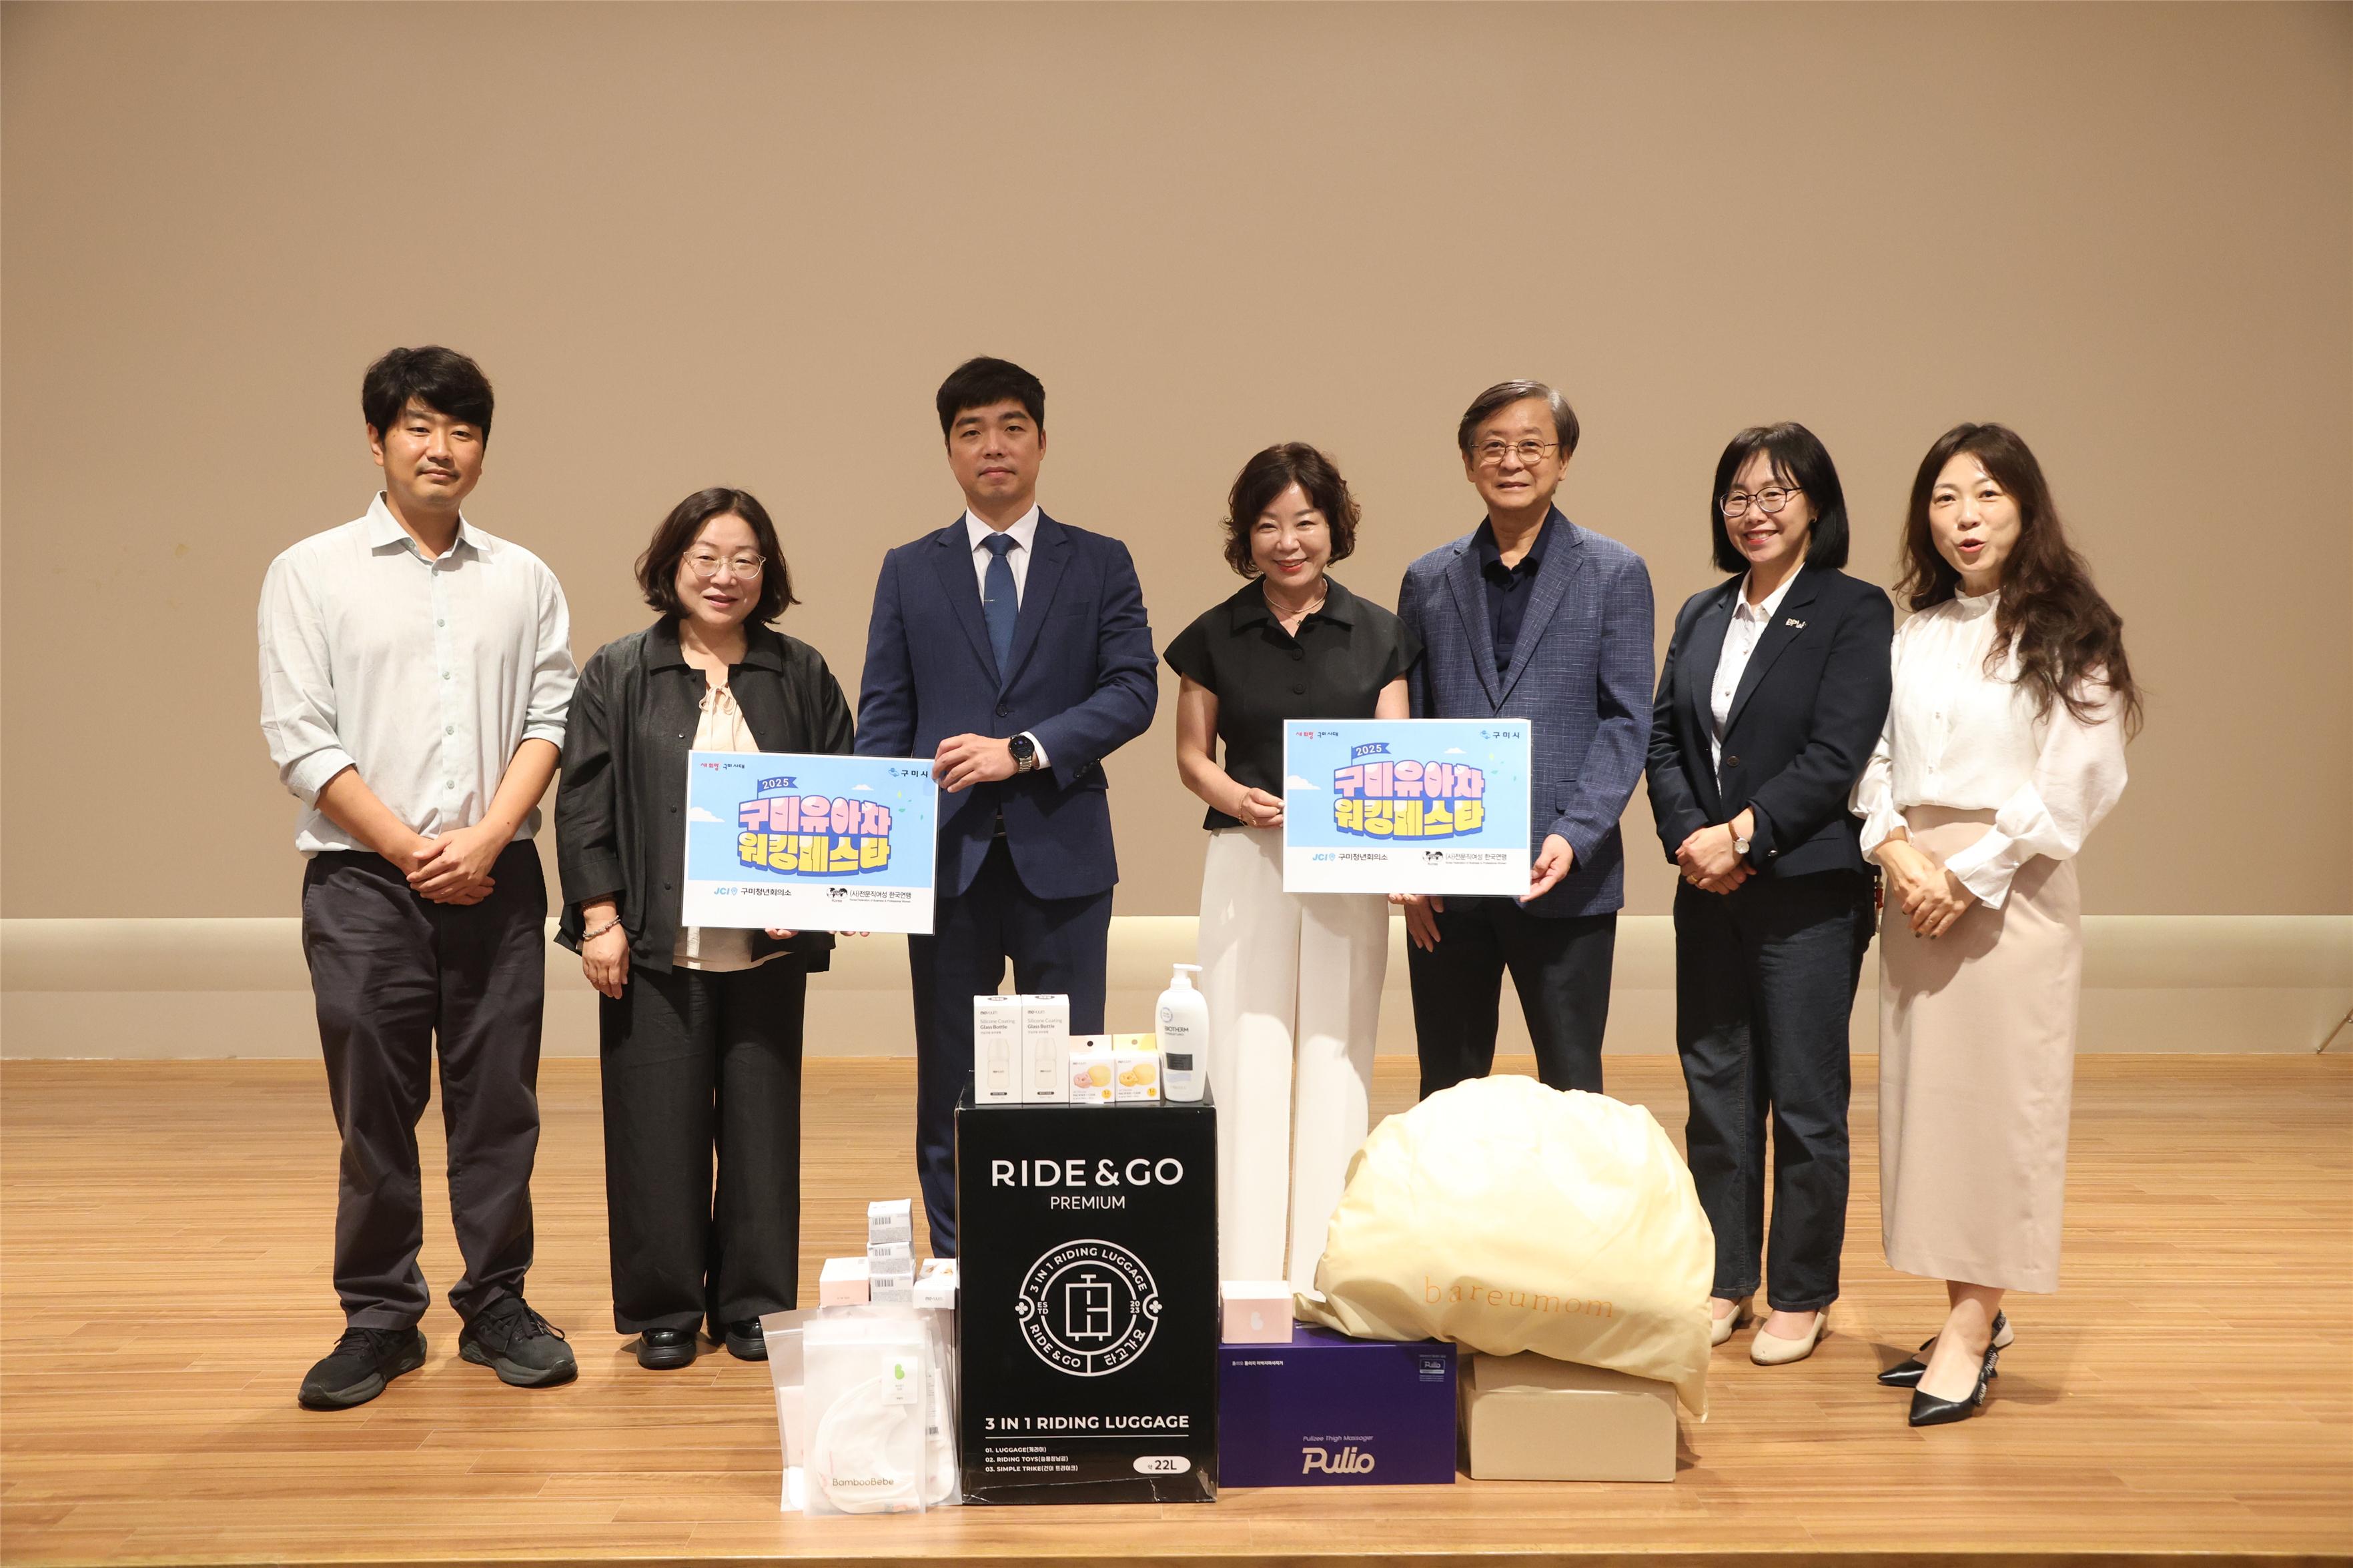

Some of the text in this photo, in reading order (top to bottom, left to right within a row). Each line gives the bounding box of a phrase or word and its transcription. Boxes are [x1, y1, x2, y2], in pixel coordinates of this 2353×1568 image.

[1356, 744, 1382, 756] 2025
[901, 770, 928, 778] 구미시
[1334, 760, 1485, 798] 구미유아차
[762, 778, 789, 790] 2025
[739, 795, 892, 836] 구미유아차
[1334, 798, 1485, 839] 워킹페스타
[737, 832, 891, 876] 워킹페스타
[1312, 853, 1328, 861] JCI
[1338, 853, 1388, 861] 구미청년회의소
[714, 887, 730, 895] JCI
[741, 888, 792, 896] 구미청년회의소
[991, 1159, 1086, 1187] RIDE
[1050, 1196, 1125, 1210] PREMIUM
[1029, 1285, 1039, 1293] 3
[1035, 1269, 1048, 1283] IN
[1053, 1247, 1097, 1265] RIDING
[1101, 1249, 1147, 1292] LUGGAGE
[1424, 1275, 1613, 1318] bareumom
[1029, 1324, 1053, 1354] RIDE
[1103, 1329, 1145, 1366] 타고가요
[985, 1415, 1190, 1430] 3 IN 1 RIDING LUGGAGE
[1155, 1459, 1177, 1470] 22L
[1302, 1447, 1375, 1474] Pulio
[832, 1477, 894, 1487] BambooBebe
